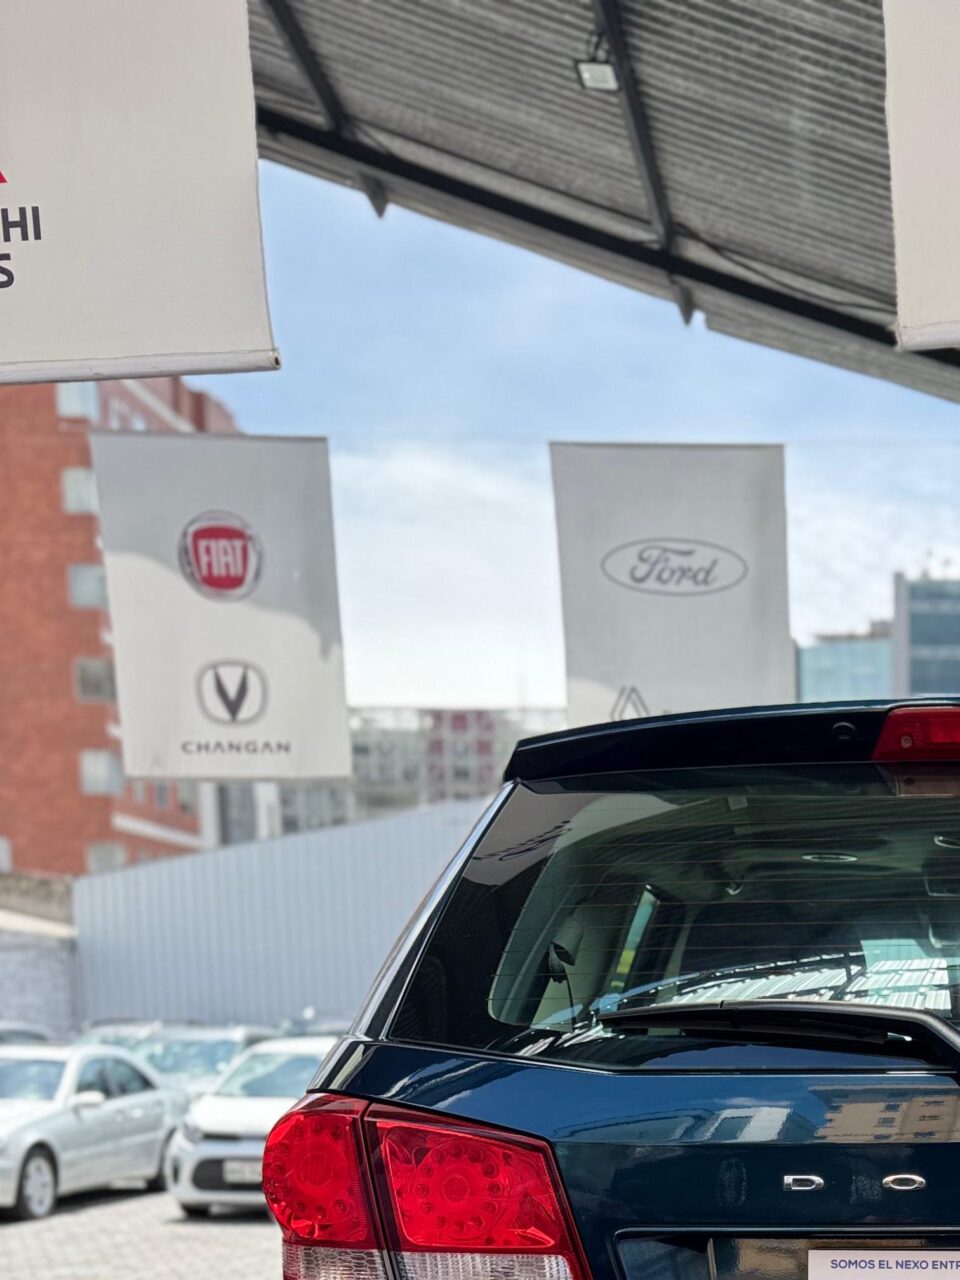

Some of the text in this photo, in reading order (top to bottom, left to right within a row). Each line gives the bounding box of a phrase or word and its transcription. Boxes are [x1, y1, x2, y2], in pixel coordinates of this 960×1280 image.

[198, 538, 246, 578] FIAT
[629, 545, 719, 586] Ford
[180, 740, 292, 755] CHANGAN
[830, 1259, 876, 1270] SOMOS
[878, 1259, 893, 1270] EL
[895, 1260, 929, 1270] NEXO
